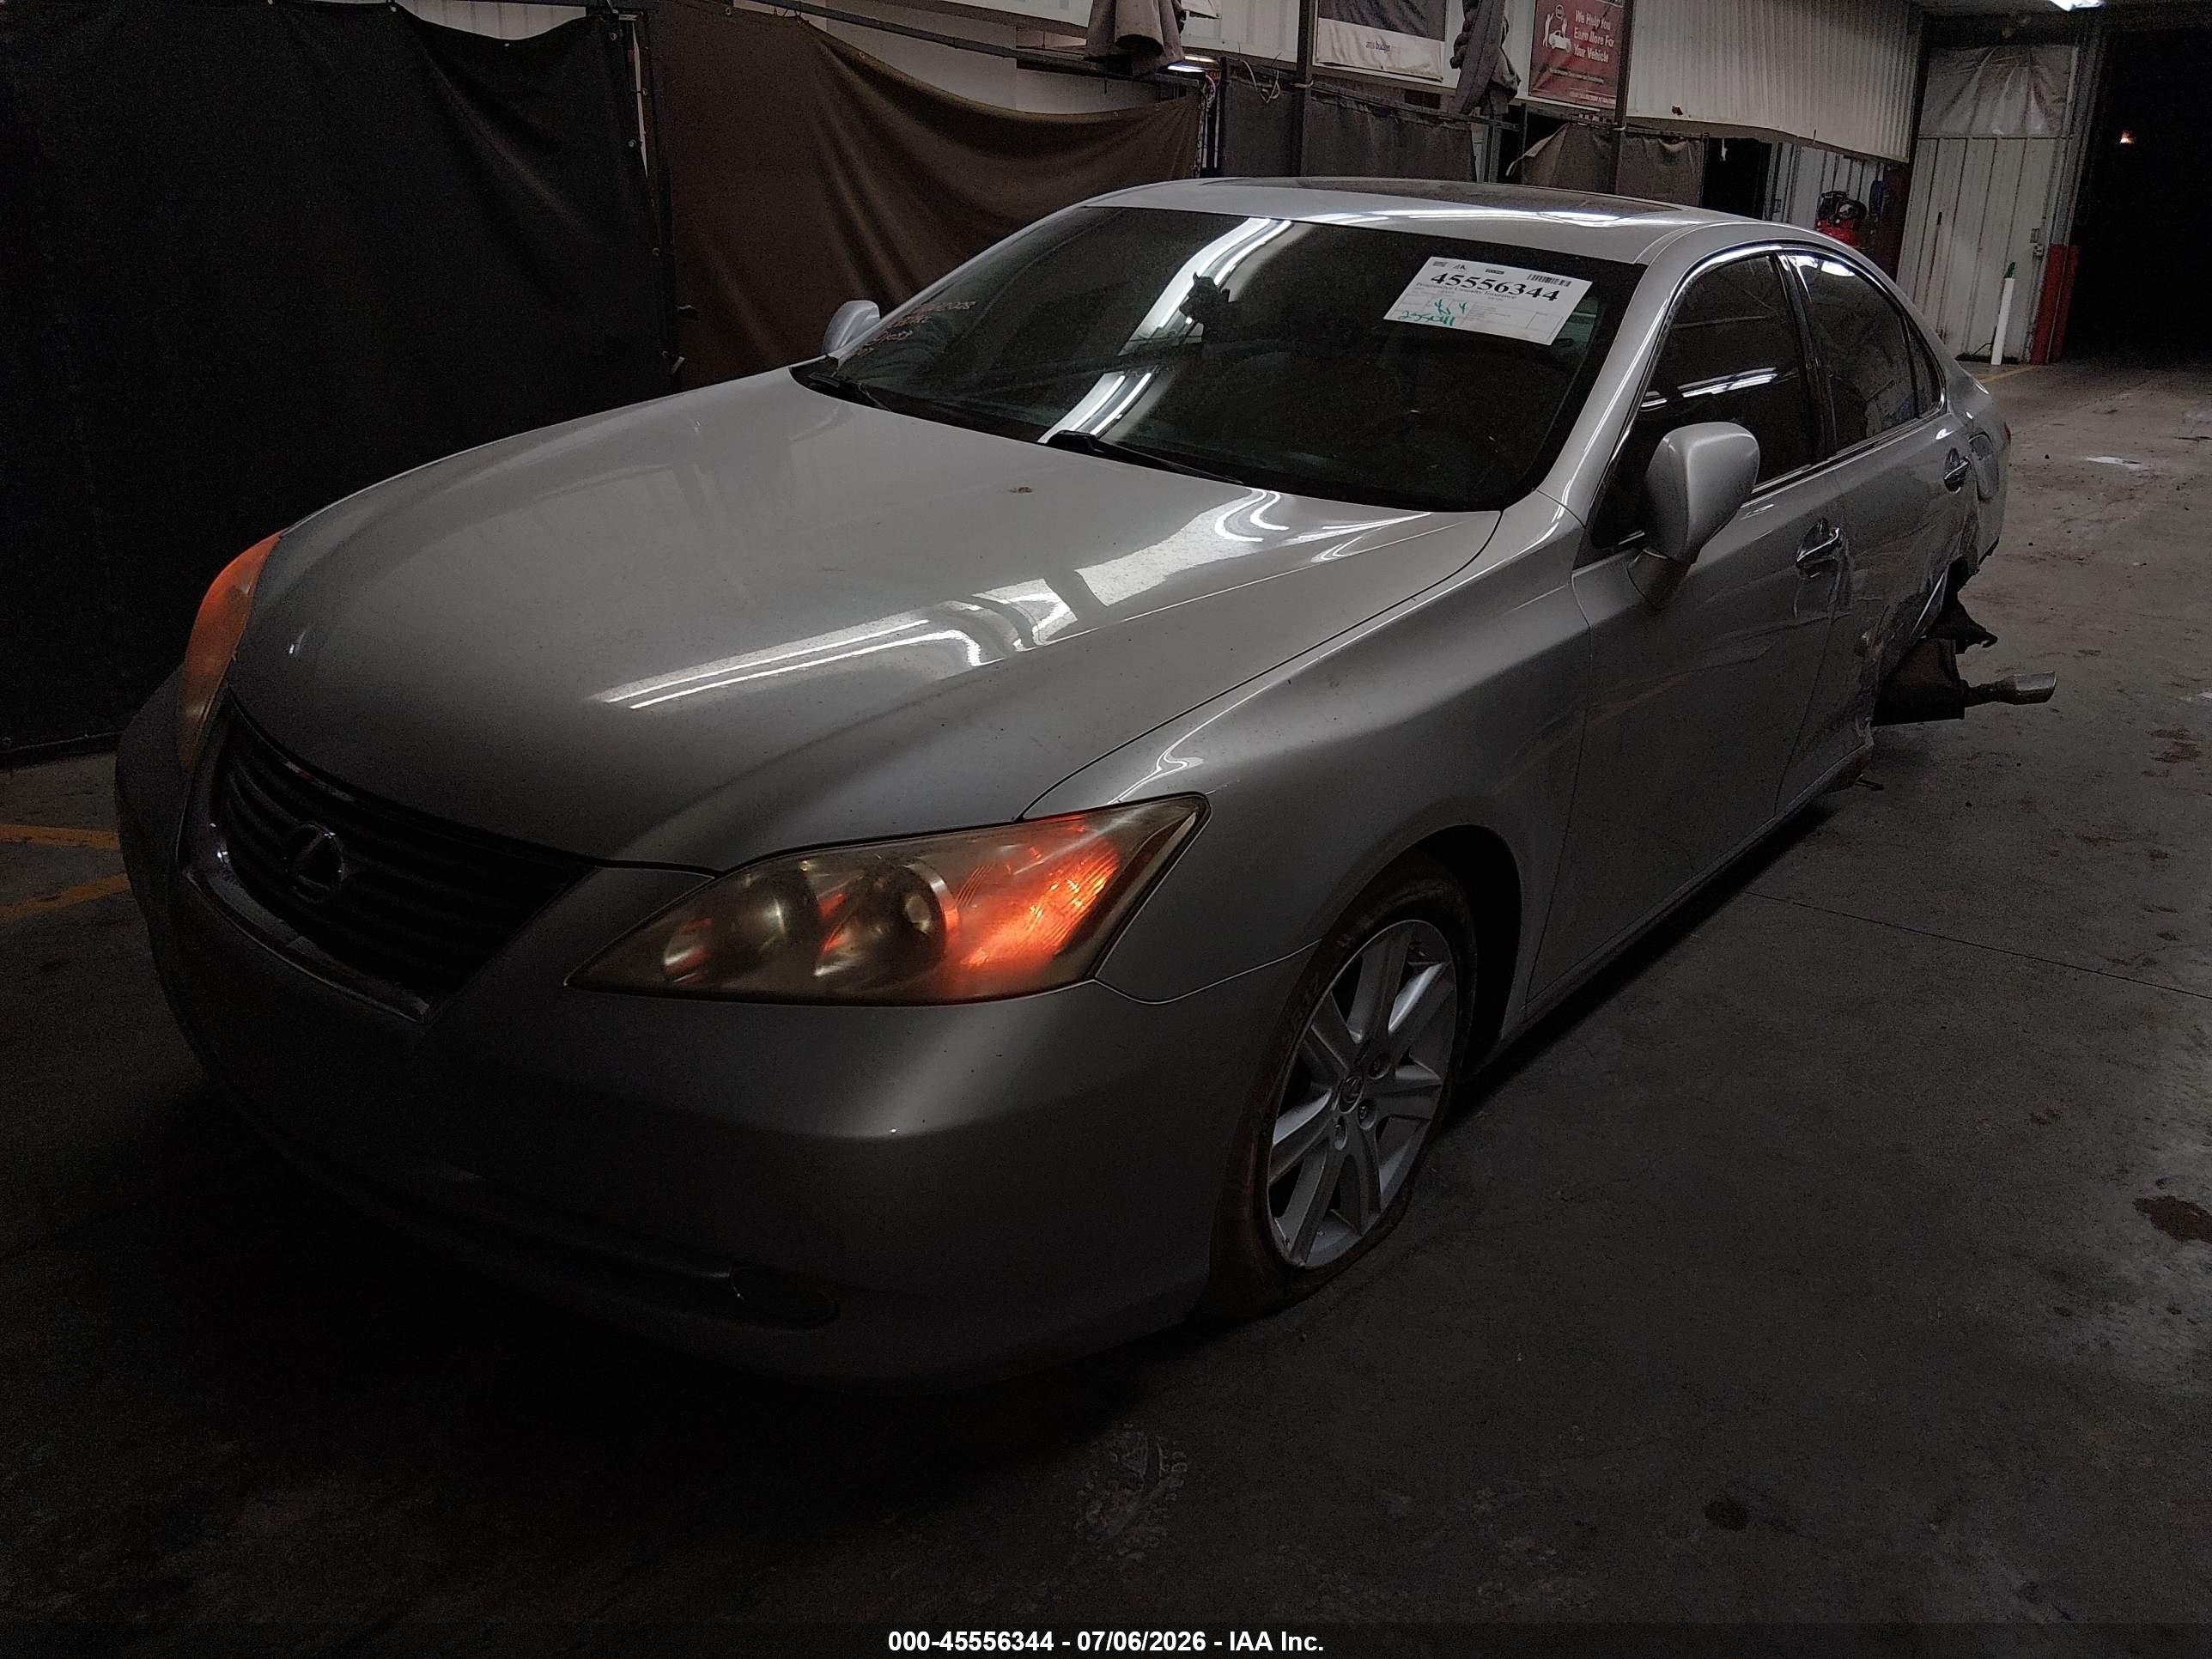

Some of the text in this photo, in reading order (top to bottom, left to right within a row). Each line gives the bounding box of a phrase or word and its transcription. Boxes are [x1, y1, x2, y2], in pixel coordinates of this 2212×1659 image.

[1575, 9, 1585, 23] We
[1586, 13, 1600, 28] Help
[1601, 17, 1612, 31] You
[1573, 27, 1589, 41] Earn
[1589, 30, 1604, 45] More
[1573, 44, 1609, 63] Your Vehicle
[1431, 272, 1561, 302] 45556344
